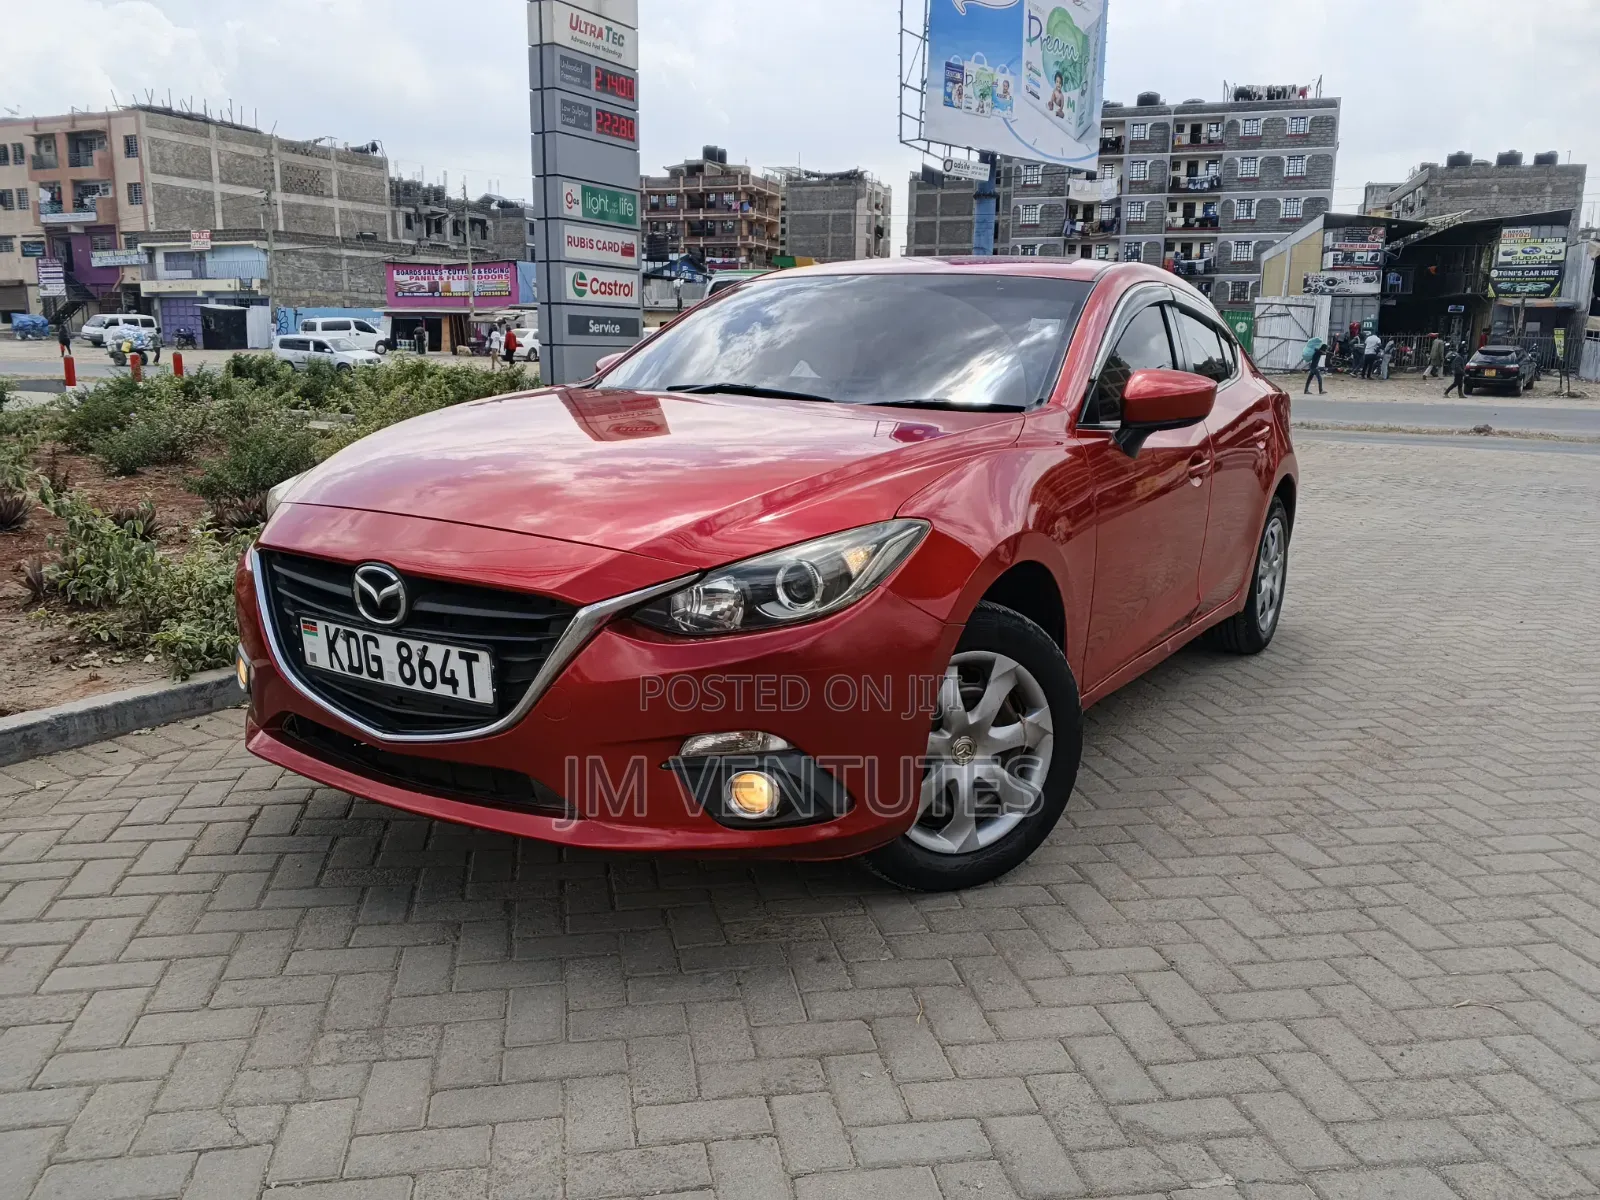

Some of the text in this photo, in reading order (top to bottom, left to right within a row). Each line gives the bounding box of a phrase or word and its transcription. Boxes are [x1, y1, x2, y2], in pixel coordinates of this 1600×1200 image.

[1026, 9, 1078, 61] Dream
[570, 35, 592, 48] Advanced
[601, 46, 623, 60] Technology
[561, 60, 583, 74] Unleaded
[561, 103, 590, 118] Low Sulphur
[561, 113, 576, 125] Diesel
[585, 191, 609, 215] light
[619, 196, 634, 217] life
[595, 239, 620, 253] CARD
[447, 268, 478, 276] CUTTIG
[484, 267, 510, 275] EDGING
[590, 277, 634, 298] Castrol
[588, 320, 621, 334] Service
[324, 624, 480, 699] KDG 864T
